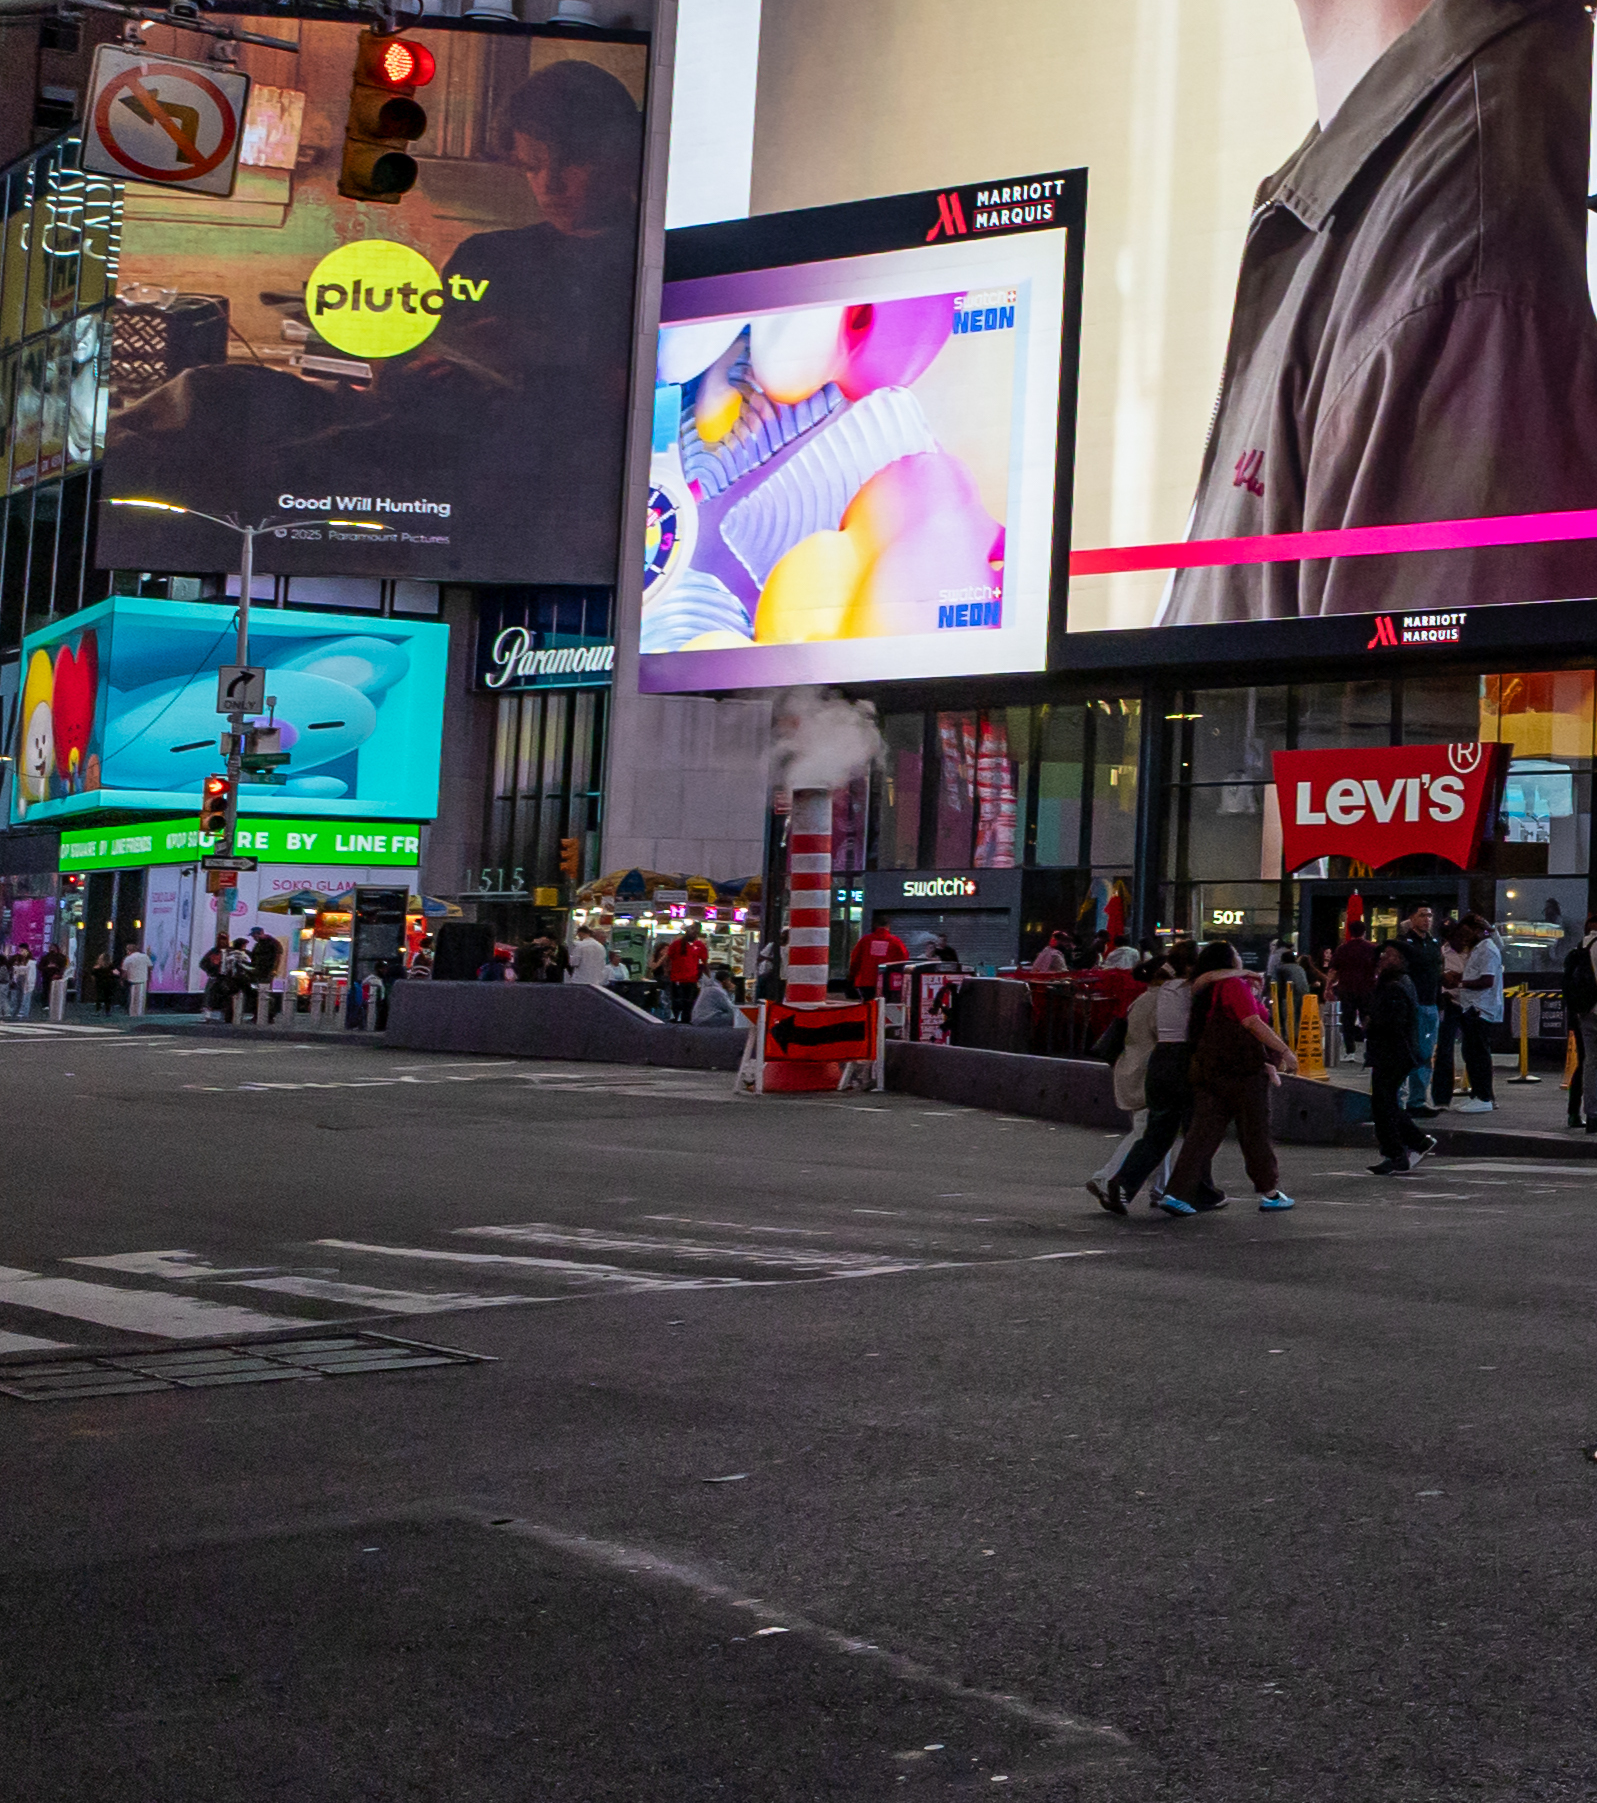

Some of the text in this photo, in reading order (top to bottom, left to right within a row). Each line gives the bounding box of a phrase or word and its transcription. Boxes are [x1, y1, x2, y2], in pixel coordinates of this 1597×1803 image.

[976, 179, 1065, 207] MARRIOTT
[975, 202, 1053, 229] MARQUIS
[315, 274, 490, 316] pluto tv
[952, 305, 1015, 335] NEON
[278, 494, 451, 517] Good Will Hunting
[291, 529, 322, 540] 2025
[328, 529, 398, 542] Paramount
[401, 531, 450, 544] Pictures
[938, 601, 1001, 629] NEON
[1402, 612, 1467, 628] MARRIOTT
[1402, 628, 1459, 643] MARQUIS
[485, 626, 615, 688] Paramoun
[286, 833, 318, 850] BY
[334, 834, 389, 853] LINE
[272, 879, 356, 892] SOKO GLAM
[465, 867, 525, 893] 1515
[902, 877, 965, 897] swatch
